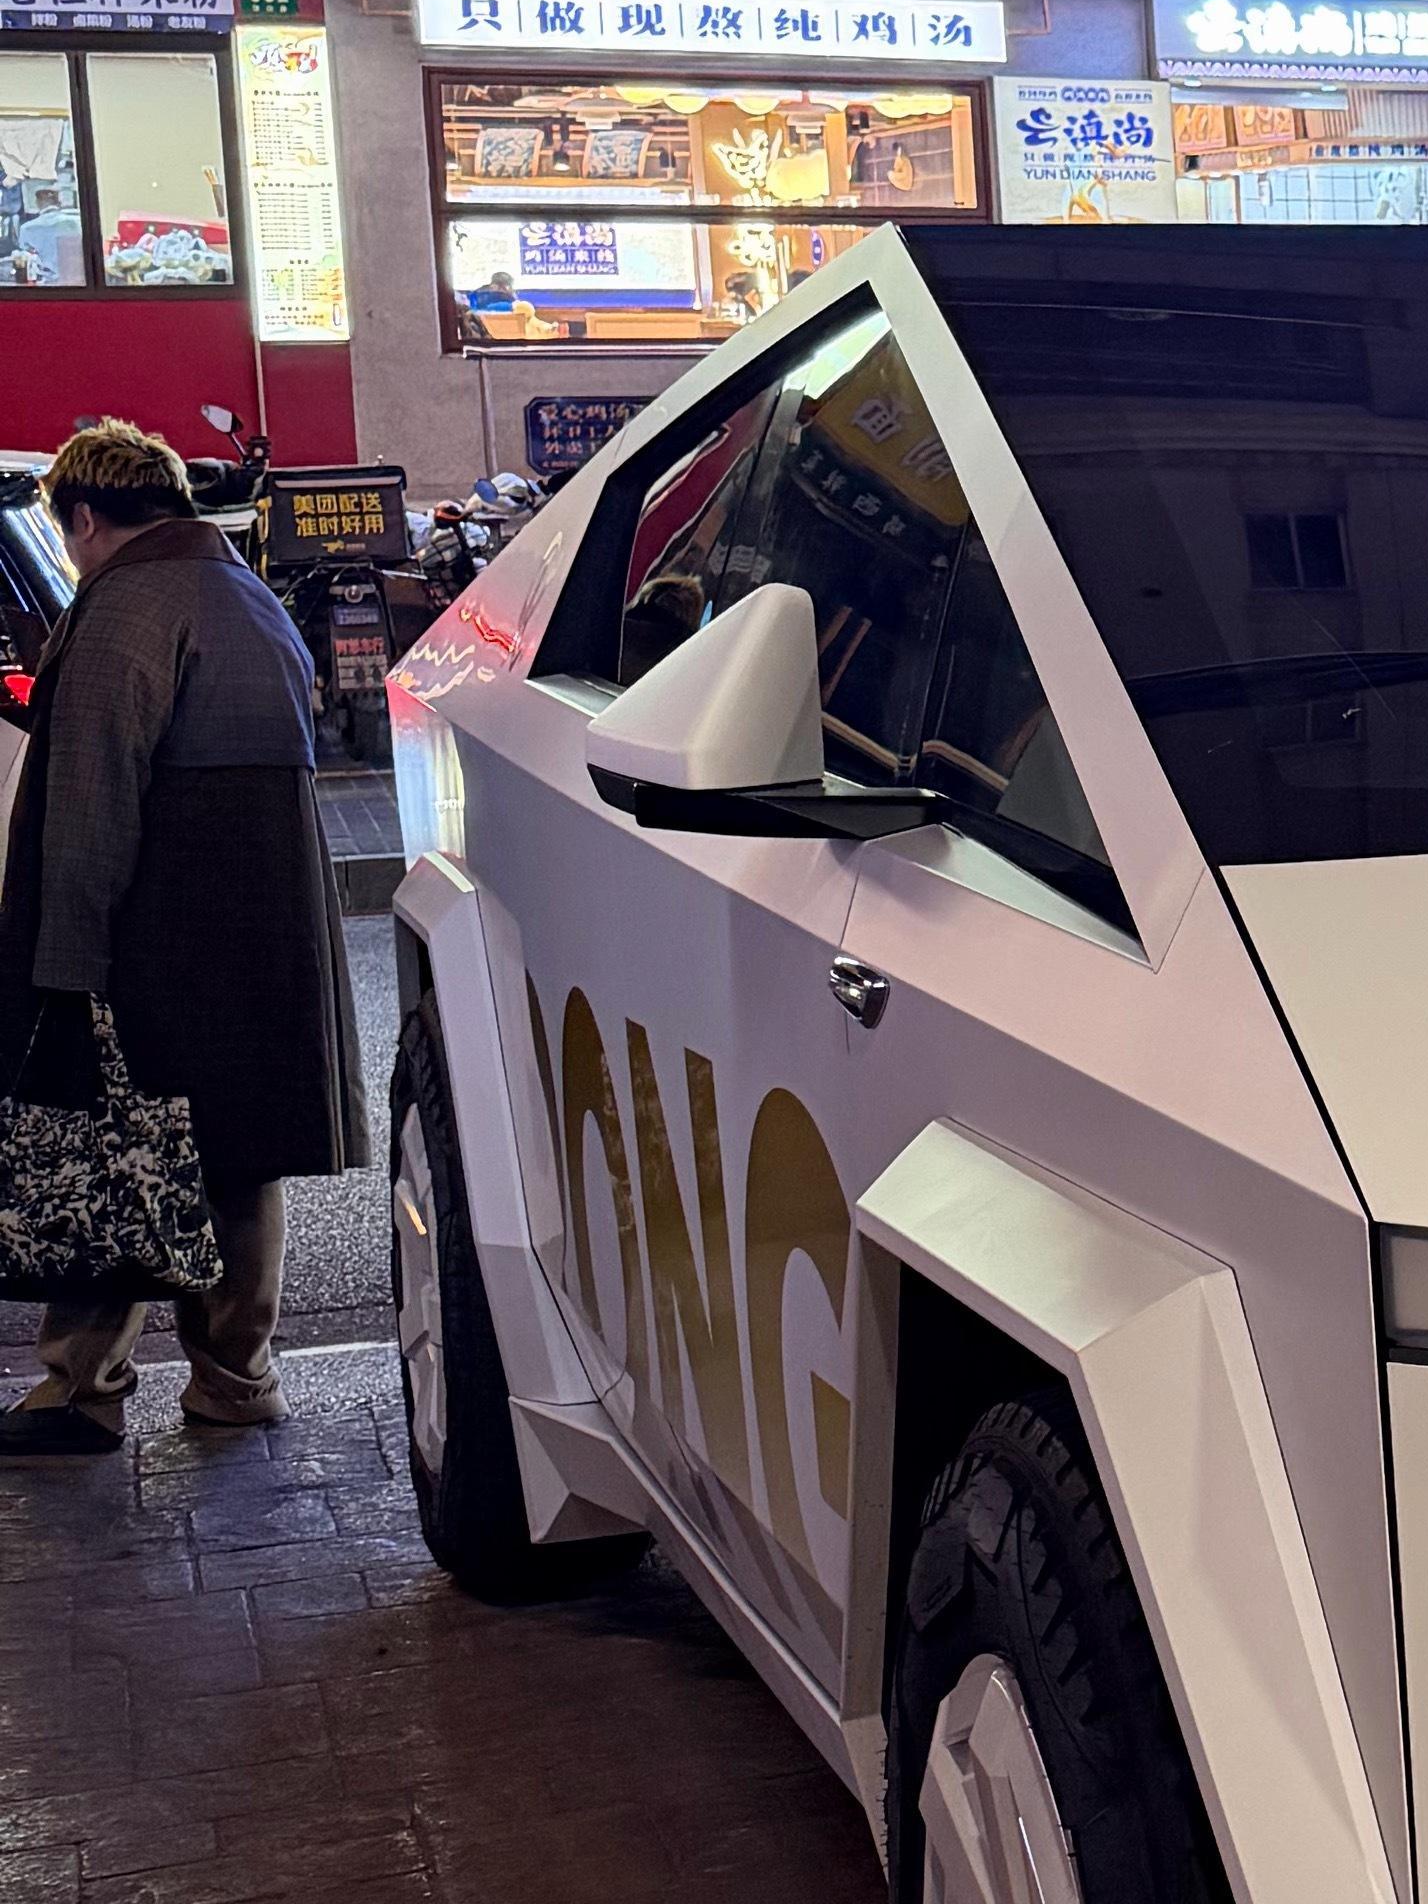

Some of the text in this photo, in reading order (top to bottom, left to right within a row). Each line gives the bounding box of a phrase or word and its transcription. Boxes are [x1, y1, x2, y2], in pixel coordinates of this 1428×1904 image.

[1024, 169, 1056, 180] YUN
[1101, 170, 1157, 181] SHANG
[293, 493, 382, 515] 美团配送
[296, 514, 384, 537] 准时好用
